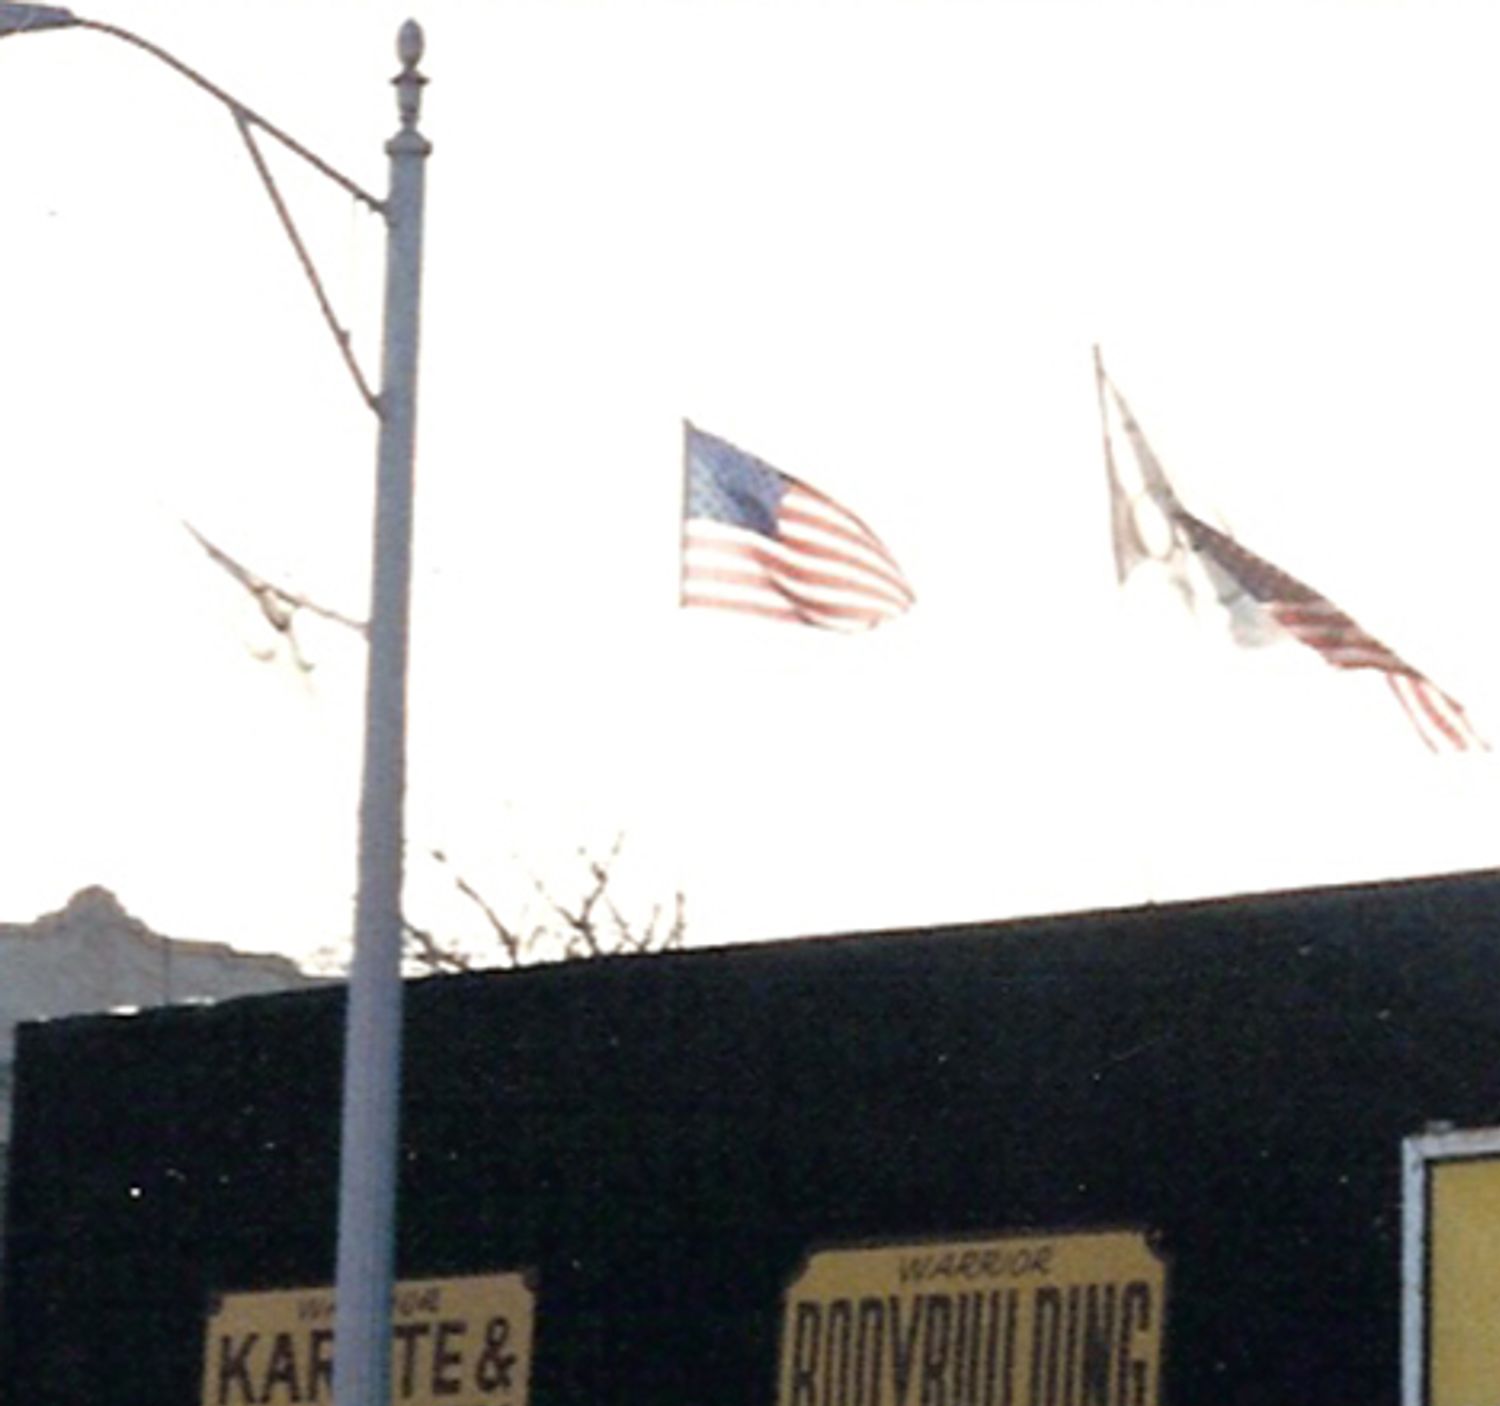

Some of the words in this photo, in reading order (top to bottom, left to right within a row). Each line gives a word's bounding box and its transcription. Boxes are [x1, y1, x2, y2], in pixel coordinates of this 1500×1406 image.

[900, 1246, 1055, 1283] WARRIOR
[216, 1320, 467, 1405] KARTE
[475, 1316, 517, 1394] &
